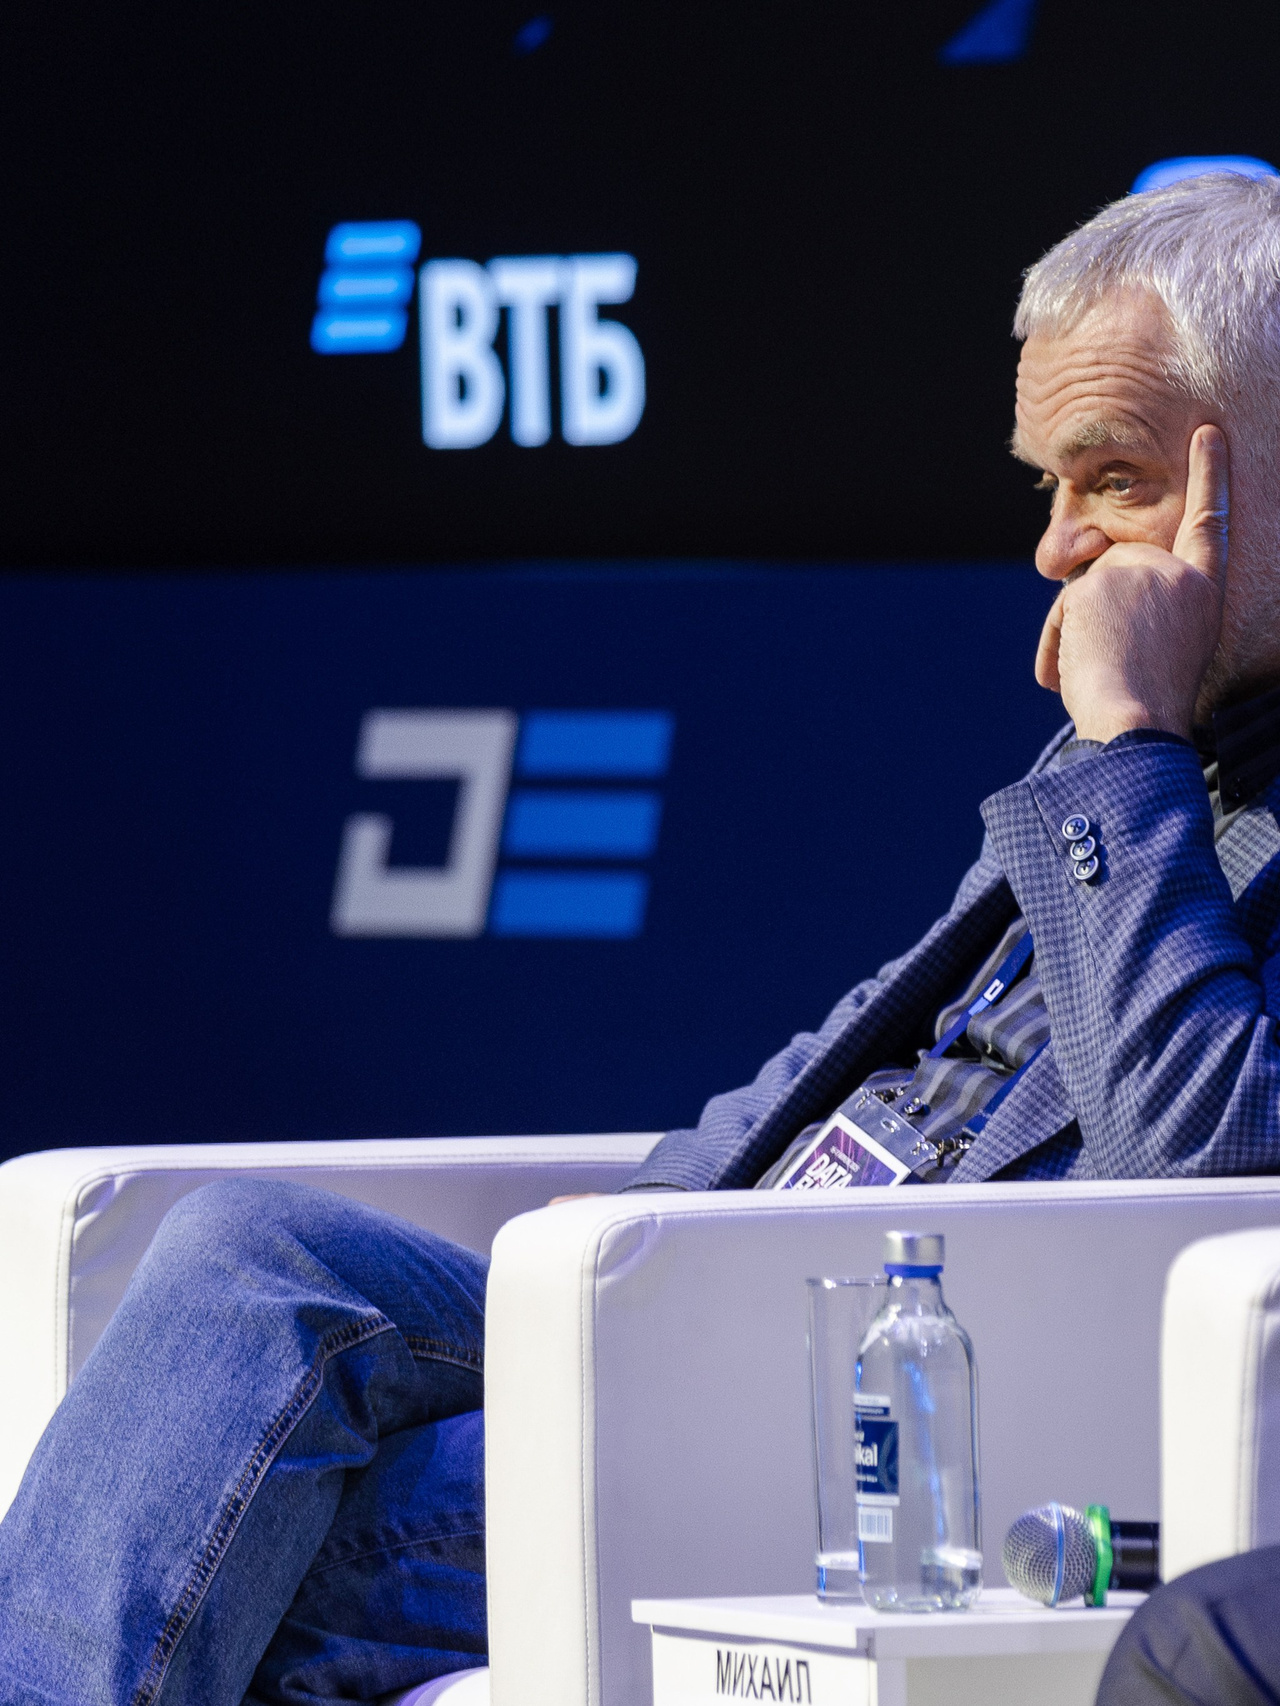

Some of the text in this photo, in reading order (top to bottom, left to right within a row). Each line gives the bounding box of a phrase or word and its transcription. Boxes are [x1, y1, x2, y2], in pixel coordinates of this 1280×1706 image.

[420, 253, 646, 449] ВТБ
[806, 1152, 853, 1189] DATA
[716, 1649, 812, 1704] МИХАИЛ
